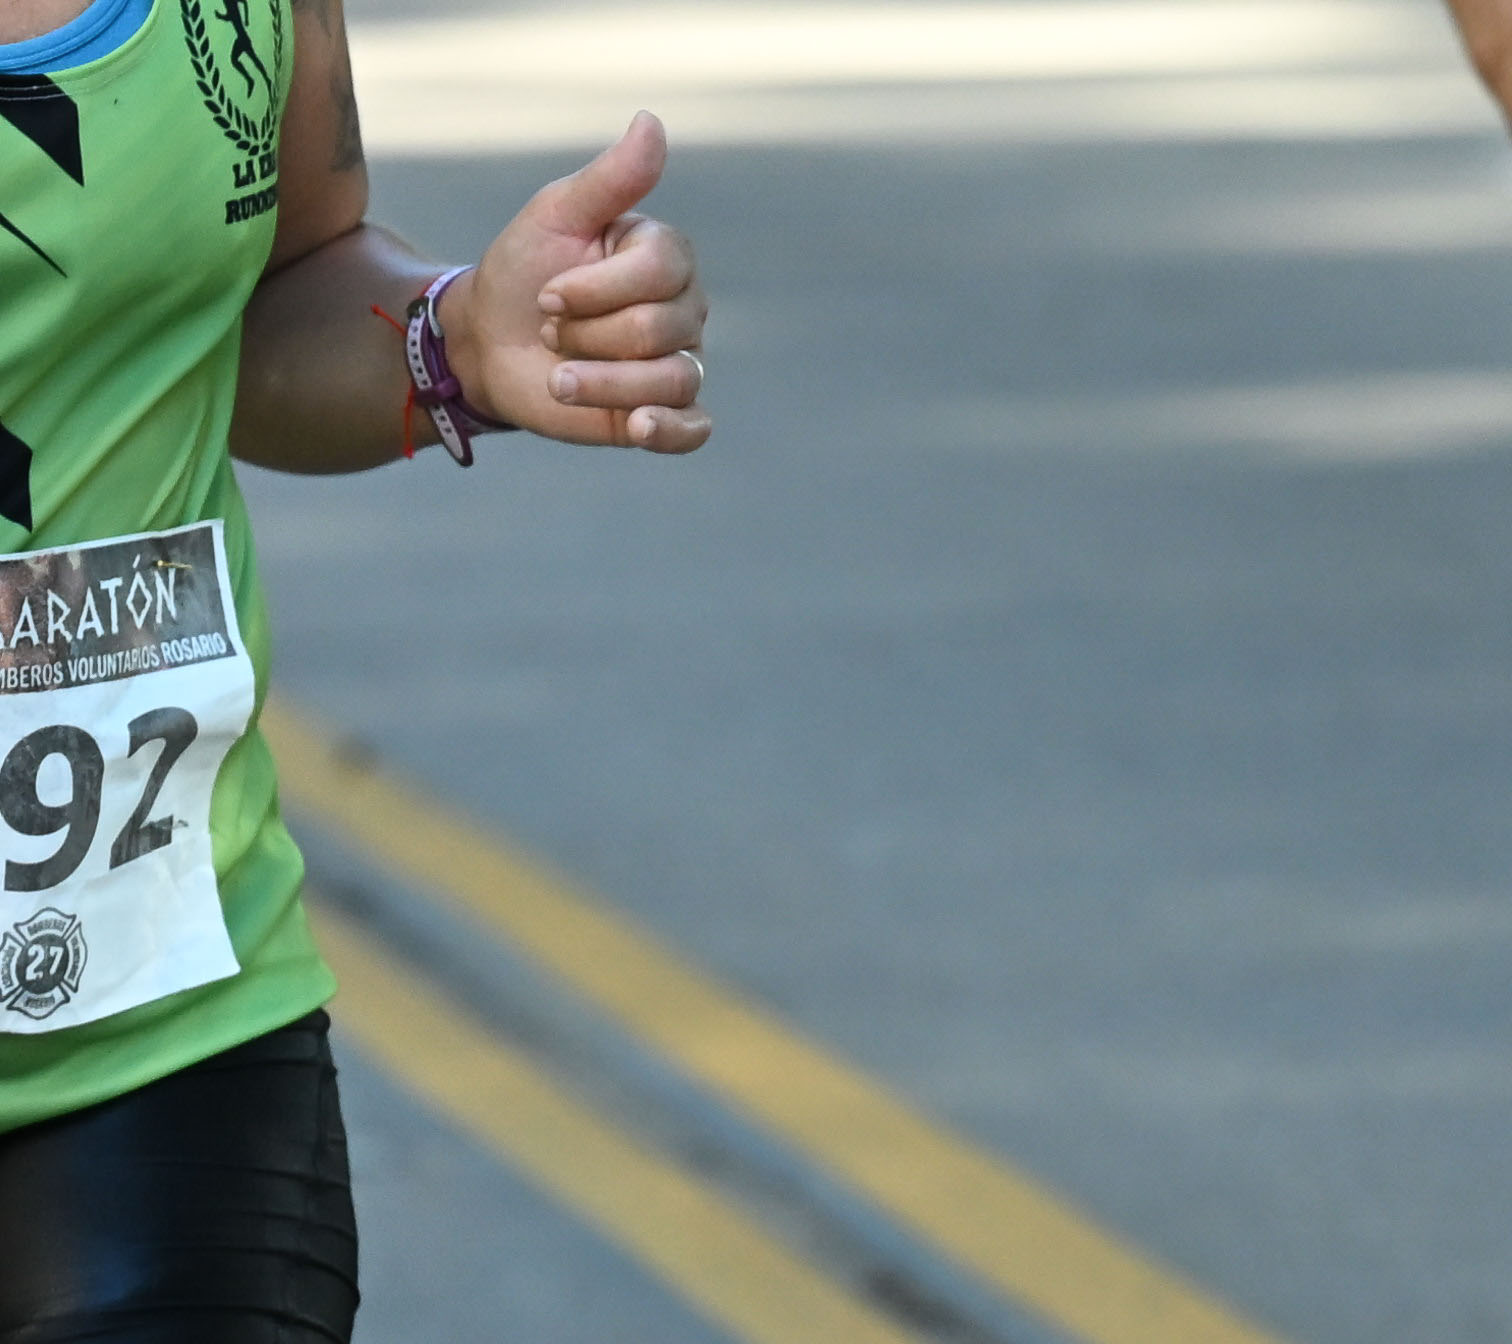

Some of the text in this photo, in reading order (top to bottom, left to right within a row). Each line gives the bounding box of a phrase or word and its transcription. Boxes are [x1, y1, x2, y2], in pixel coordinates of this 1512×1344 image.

[232, 159, 257, 189] LA
[67, 643, 160, 682] VOLUNTARIOS
[161, 631, 227, 664] ROSARIO
[25, 943, 64, 981] 27
